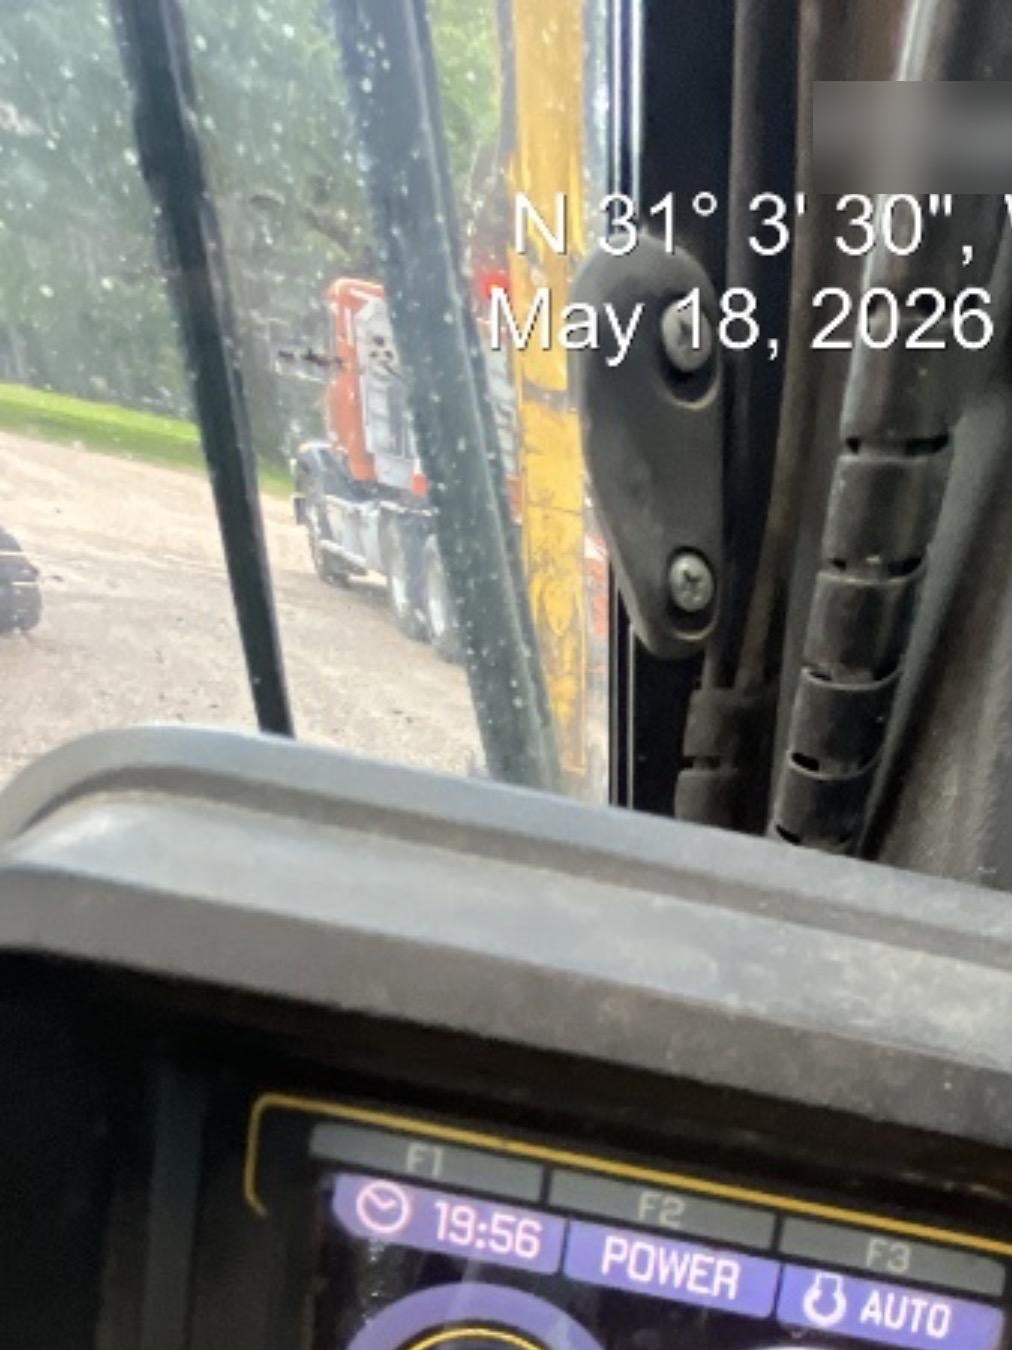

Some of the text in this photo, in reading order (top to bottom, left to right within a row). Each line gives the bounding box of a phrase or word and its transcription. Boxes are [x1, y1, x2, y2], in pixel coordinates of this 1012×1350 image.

[405, 1143, 444, 1178] F1
[434, 1201, 543, 1259] 19:56
[637, 1191, 687, 1228] F2
[601, 1235, 742, 1300] POWER
[865, 1238, 912, 1273] F3
[860, 1289, 952, 1339] AUTO
